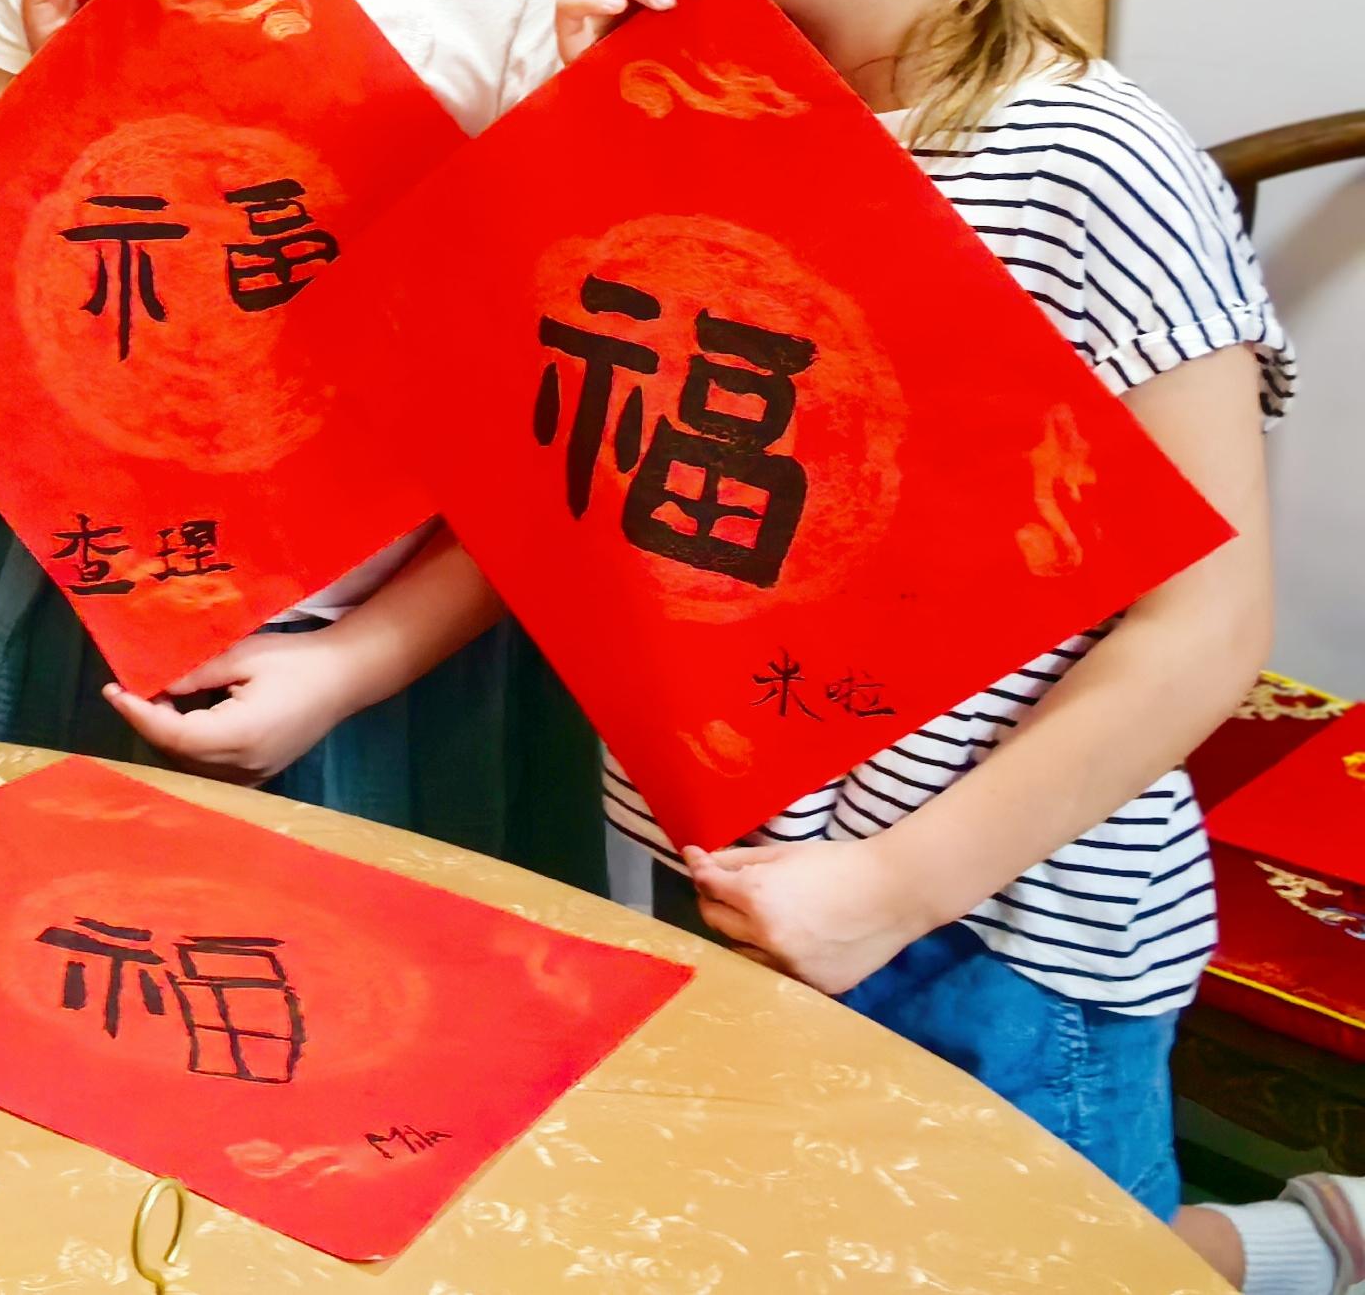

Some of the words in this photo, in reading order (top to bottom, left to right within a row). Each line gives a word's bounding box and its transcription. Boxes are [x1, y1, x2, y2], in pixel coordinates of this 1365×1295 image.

[59, 178, 339, 362] 福
[532, 274, 818, 590] 福
[51, 513, 236, 596] 查理
[35, 916, 306, 1084] 福
[364, 1124, 454, 1160] Mila
